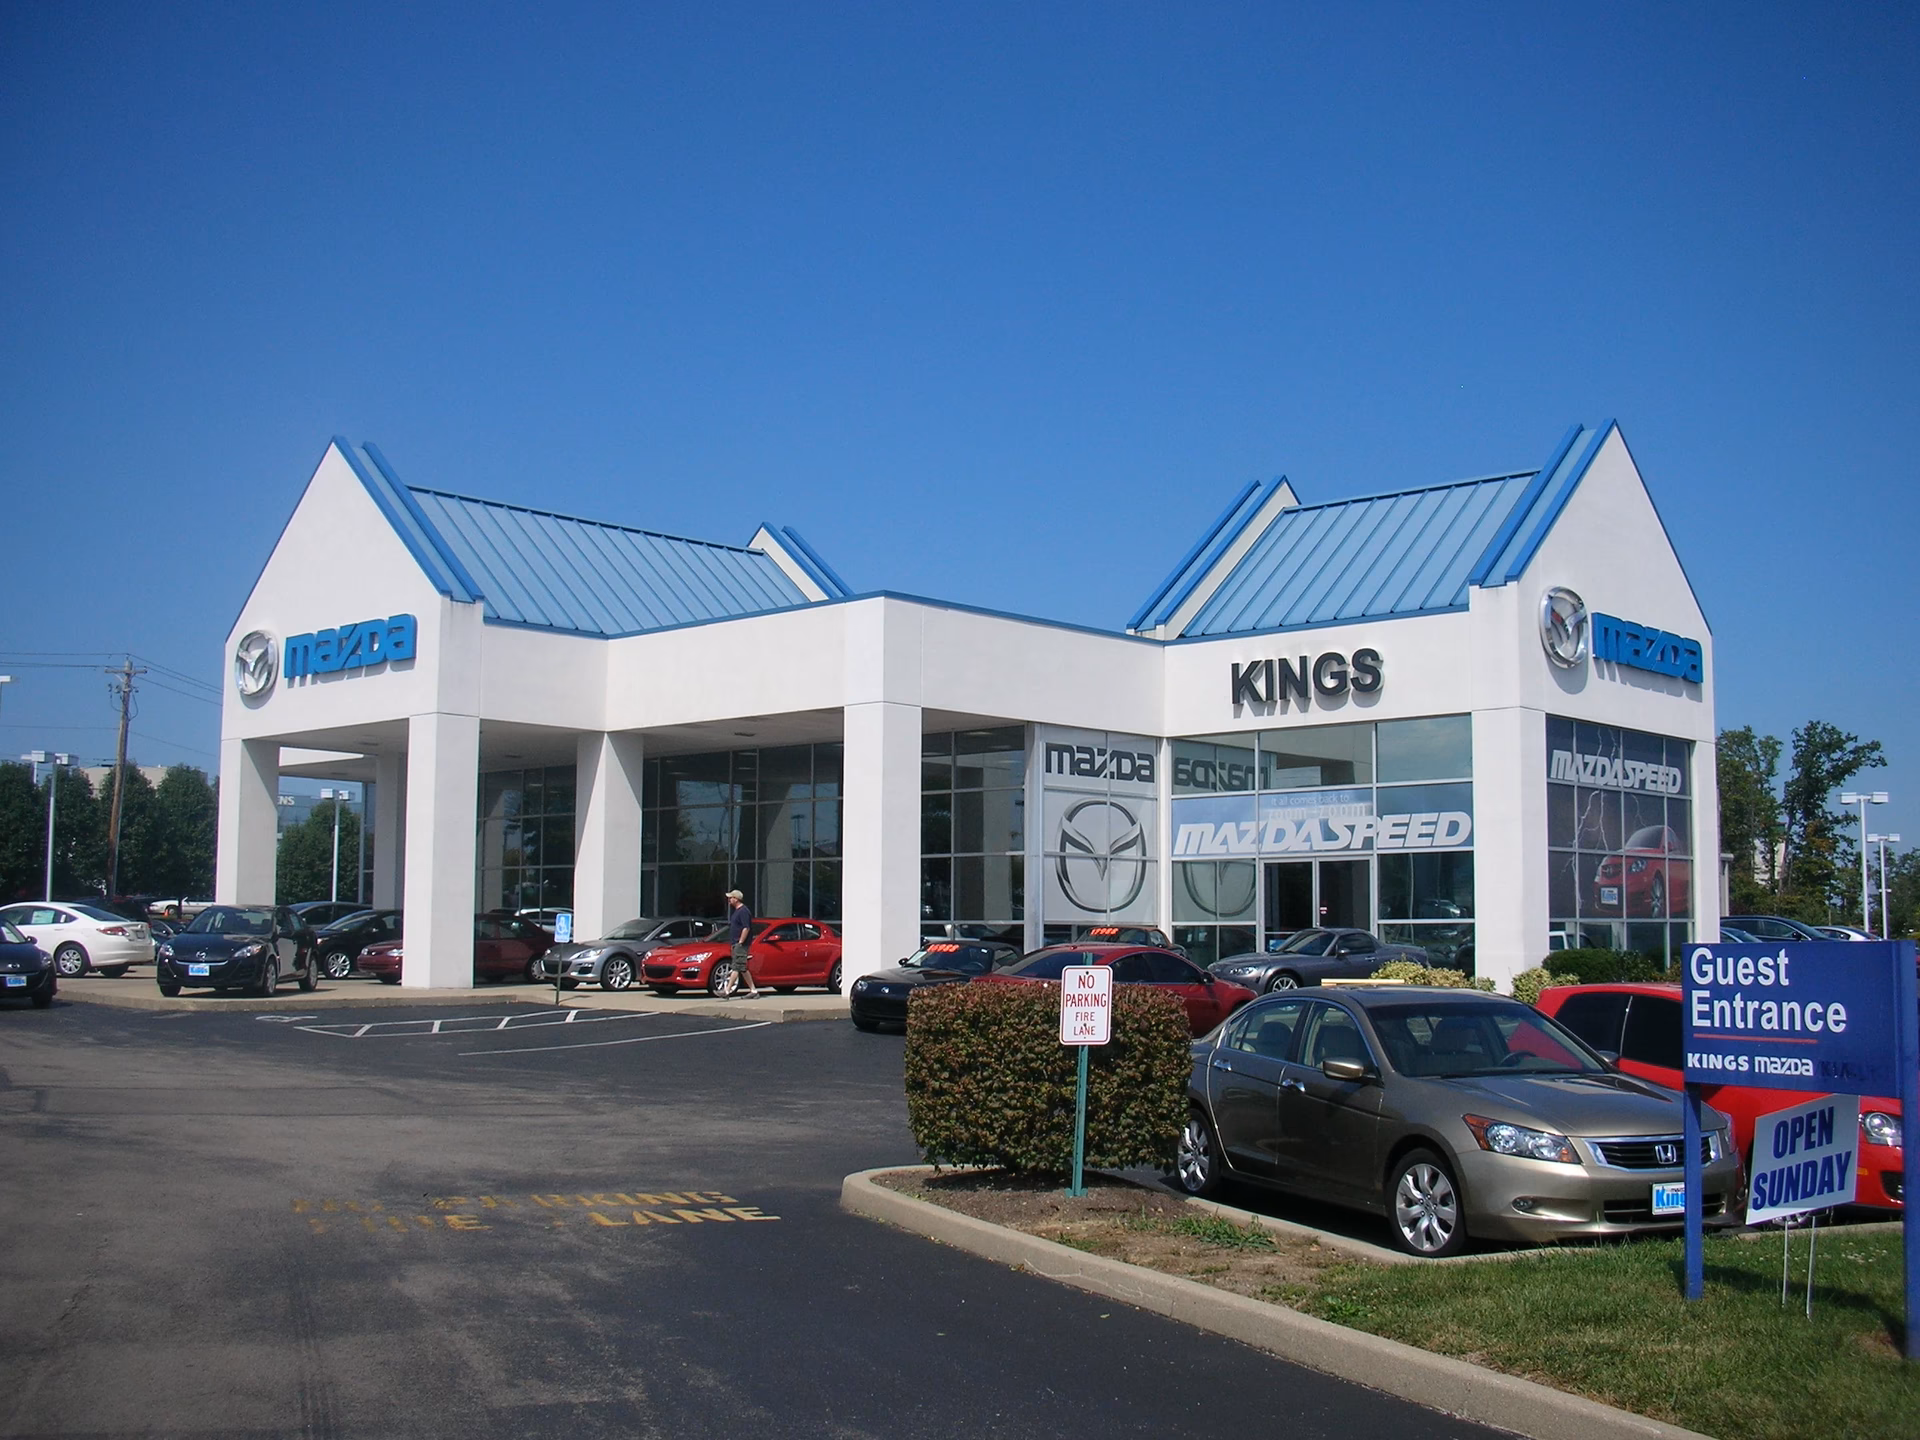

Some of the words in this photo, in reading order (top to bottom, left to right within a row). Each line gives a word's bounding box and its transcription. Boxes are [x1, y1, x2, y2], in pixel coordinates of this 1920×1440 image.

[1231, 648, 1384, 705] KINGS
[1551, 749, 1681, 794] MAZDASPEED
[1173, 811, 1473, 855] MAZDASPEED
[1078, 974, 1095, 989] NO
[1690, 947, 1789, 986] Guest
[1065, 993, 1107, 1008] PARKING
[1691, 990, 1848, 1033] Entrance
[1073, 1026, 1096, 1036] LANE
[1075, 1011, 1096, 1022] FIRE
[1687, 1053, 1749, 1072] KINGS
[1773, 1105, 1834, 1159] OPEN
[1752, 1150, 1852, 1211] SUNDAY
[1655, 1188, 1685, 1207] King
[588, 1206, 781, 1227] LANE
